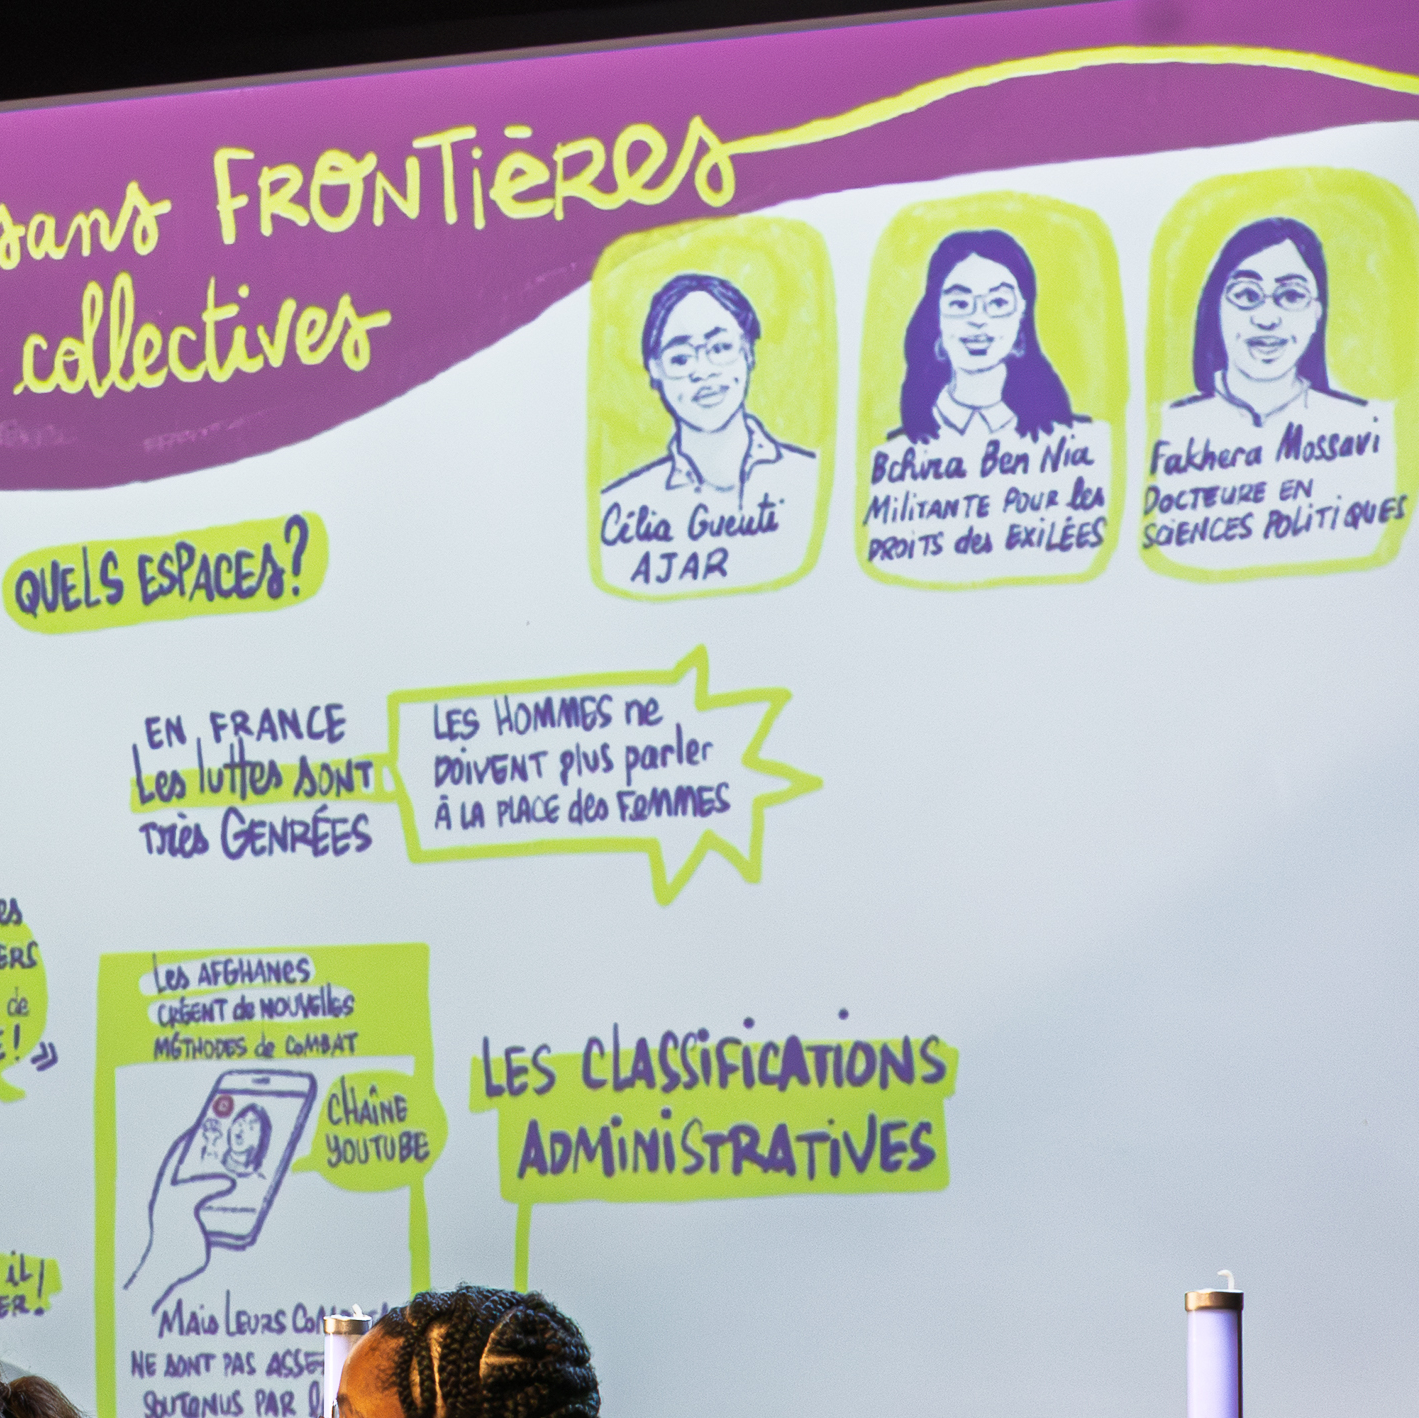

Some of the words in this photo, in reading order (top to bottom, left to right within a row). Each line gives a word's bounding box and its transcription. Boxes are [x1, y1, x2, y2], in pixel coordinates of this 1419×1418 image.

[14, 272, 391, 398] collectives
[980, 439, 1029, 477] Ben
[1040, 434, 1094, 473] Nia
[1150, 437, 1263, 475] Fakhera
[1066, 476, 1104, 511] les
[1279, 478, 1313, 501] EN
[954, 525, 993, 554] des
[15, 546, 123, 617] QUELS
[630, 547, 729, 584] AJAR
[145, 715, 187, 749] EN
[210, 704, 347, 745] FRANCE
[433, 701, 481, 742] LES
[624, 698, 664, 729] ne
[624, 722, 714, 787] parler
[461, 796, 486, 829] LA
[496, 791, 560, 828] PLACE
[567, 785, 610, 826] des
[7, 987, 29, 1017] de
[482, 1036, 557, 1098] LES
[326, 1130, 430, 1168] YOUTUBE
[131, 1350, 156, 1379] NE
[224, 1352, 256, 1376] PAS
[265, 1348, 325, 1379] ASSE
[255, 1388, 296, 1417] PAR
